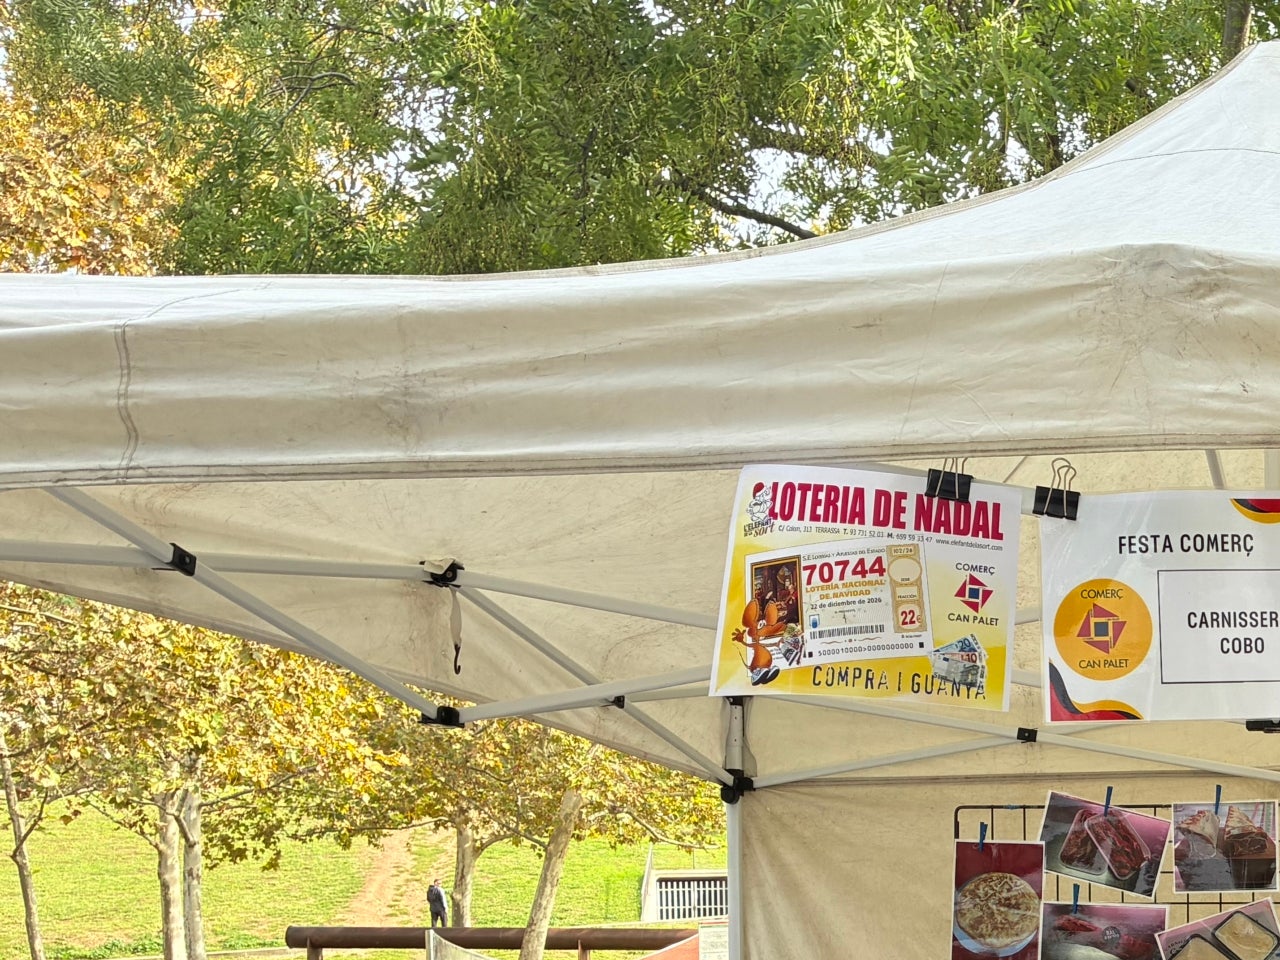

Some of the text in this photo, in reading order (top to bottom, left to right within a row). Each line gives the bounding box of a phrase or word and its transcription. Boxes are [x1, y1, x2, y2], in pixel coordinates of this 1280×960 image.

[768, 481, 1004, 541] LOTERIA DE NADAL
[815, 526, 840, 535] TERRASSA
[1117, 533, 1255, 558] FESTA COMERÇ
[802, 555, 887, 586] 70744
[955, 562, 996, 576] COMERÇ
[805, 578, 886, 593] LOTERÍA NACIONAL
[832, 589, 871, 600] NAVIDAD
[1080, 588, 1124, 601] COMERÇ
[827, 600, 857, 608] diciembre
[947, 612, 1000, 627] CAN PALET
[1220, 637, 1266, 655] COBO
[1078, 657, 1130, 669] CAN PALET
[812, 665, 889, 690] COMPRA
[911, 672, 986, 700] GUANYA
